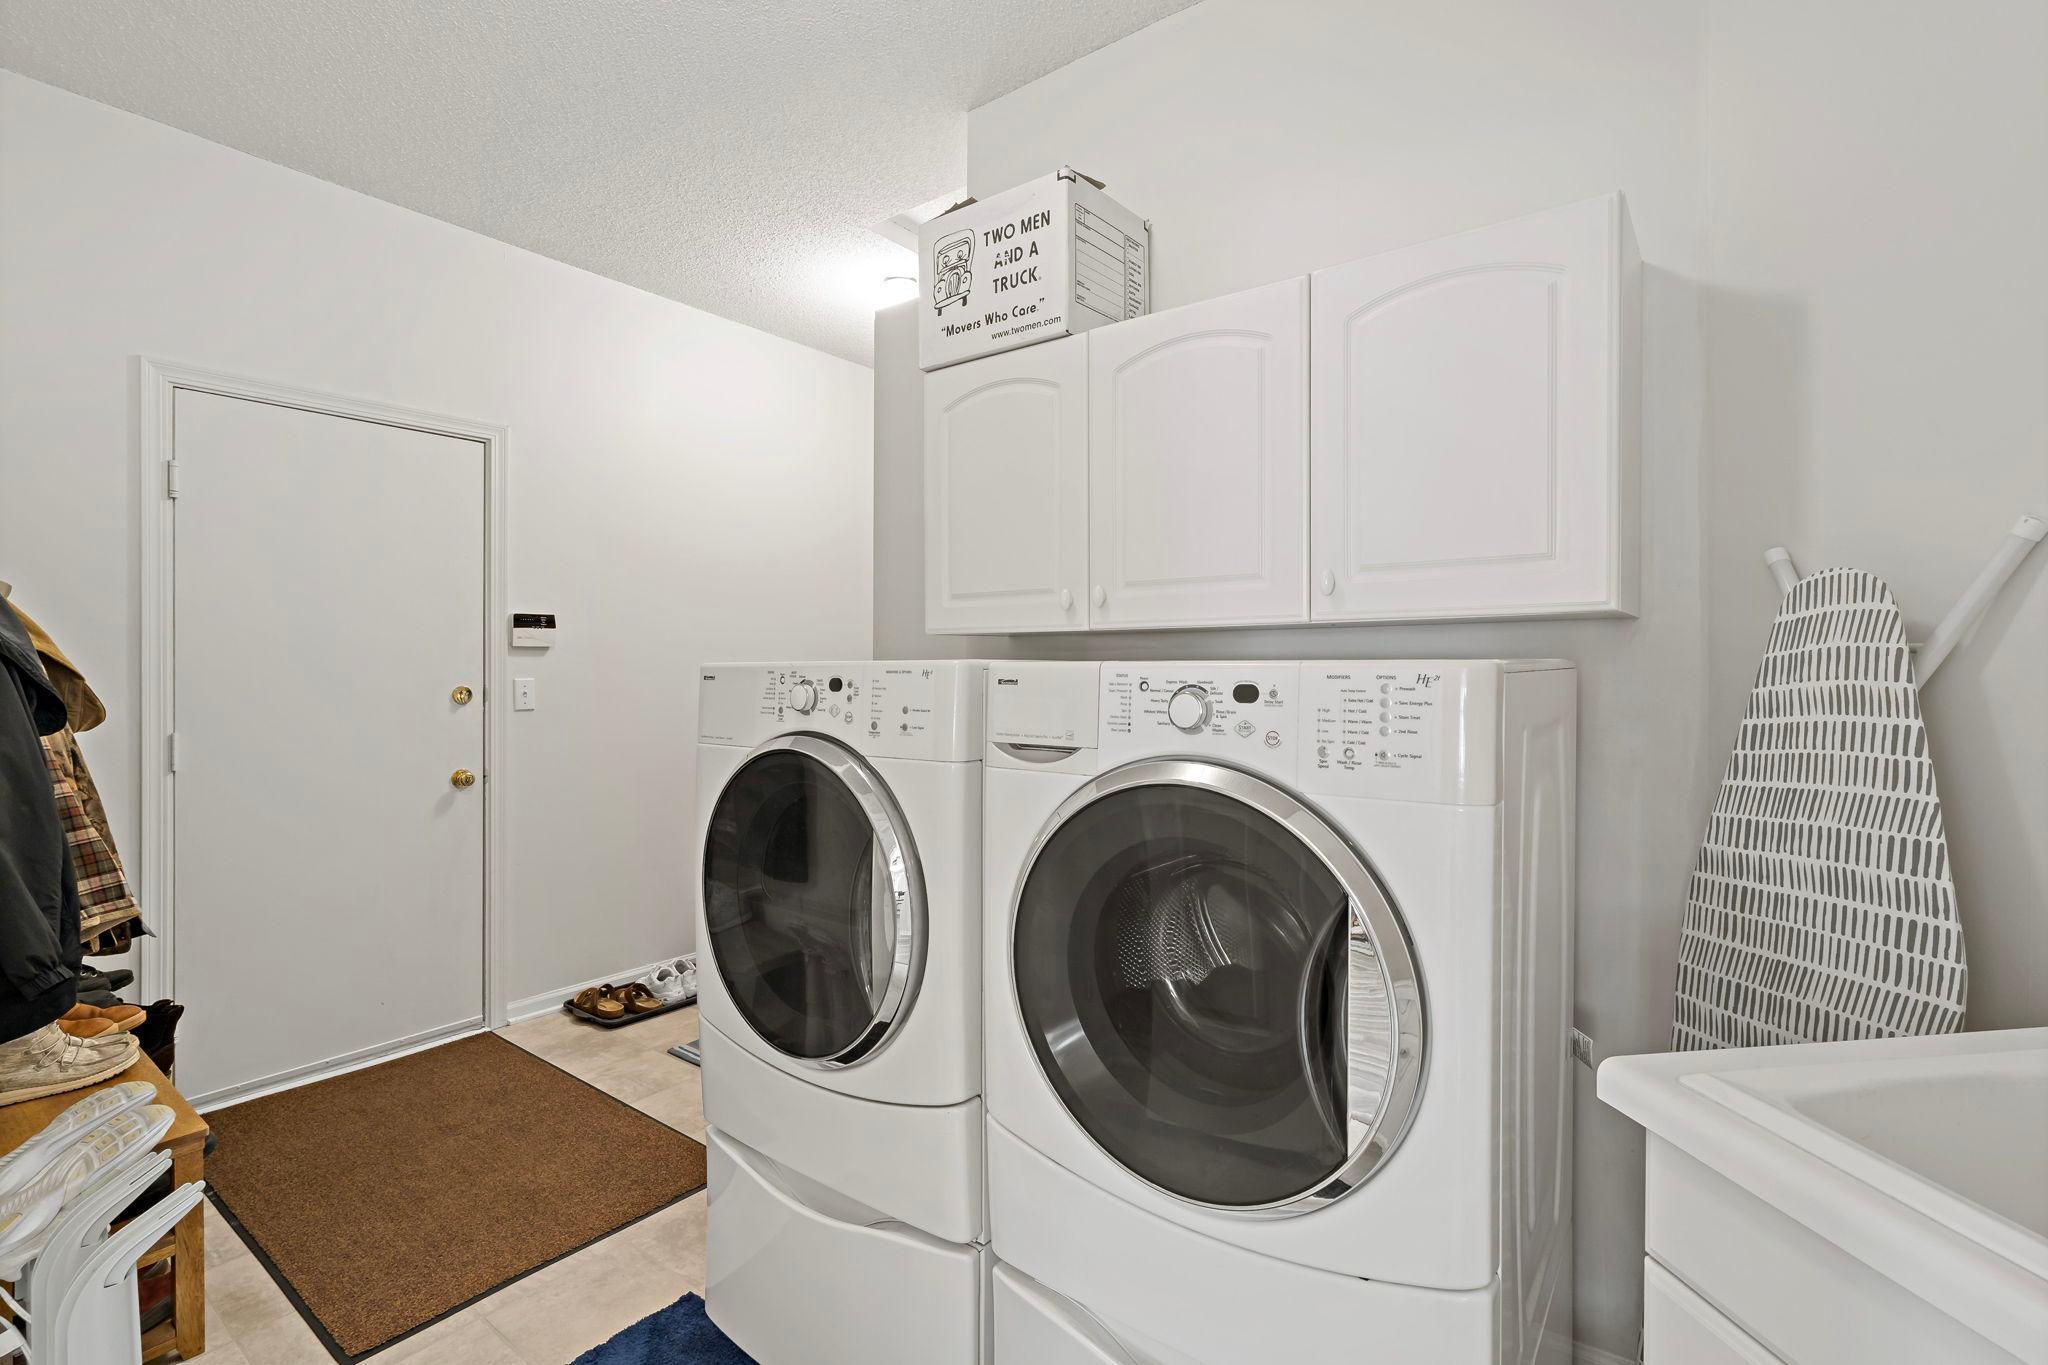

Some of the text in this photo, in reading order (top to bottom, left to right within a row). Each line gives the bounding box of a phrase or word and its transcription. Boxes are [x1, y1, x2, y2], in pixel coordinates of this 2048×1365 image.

[984, 223, 1016, 247] TWO
[1020, 210, 1051, 235] MEN
[994, 240, 1039, 269] AND A
[984, 311, 1008, 326] Who
[991, 315, 1062, 340] www.twomen.com
